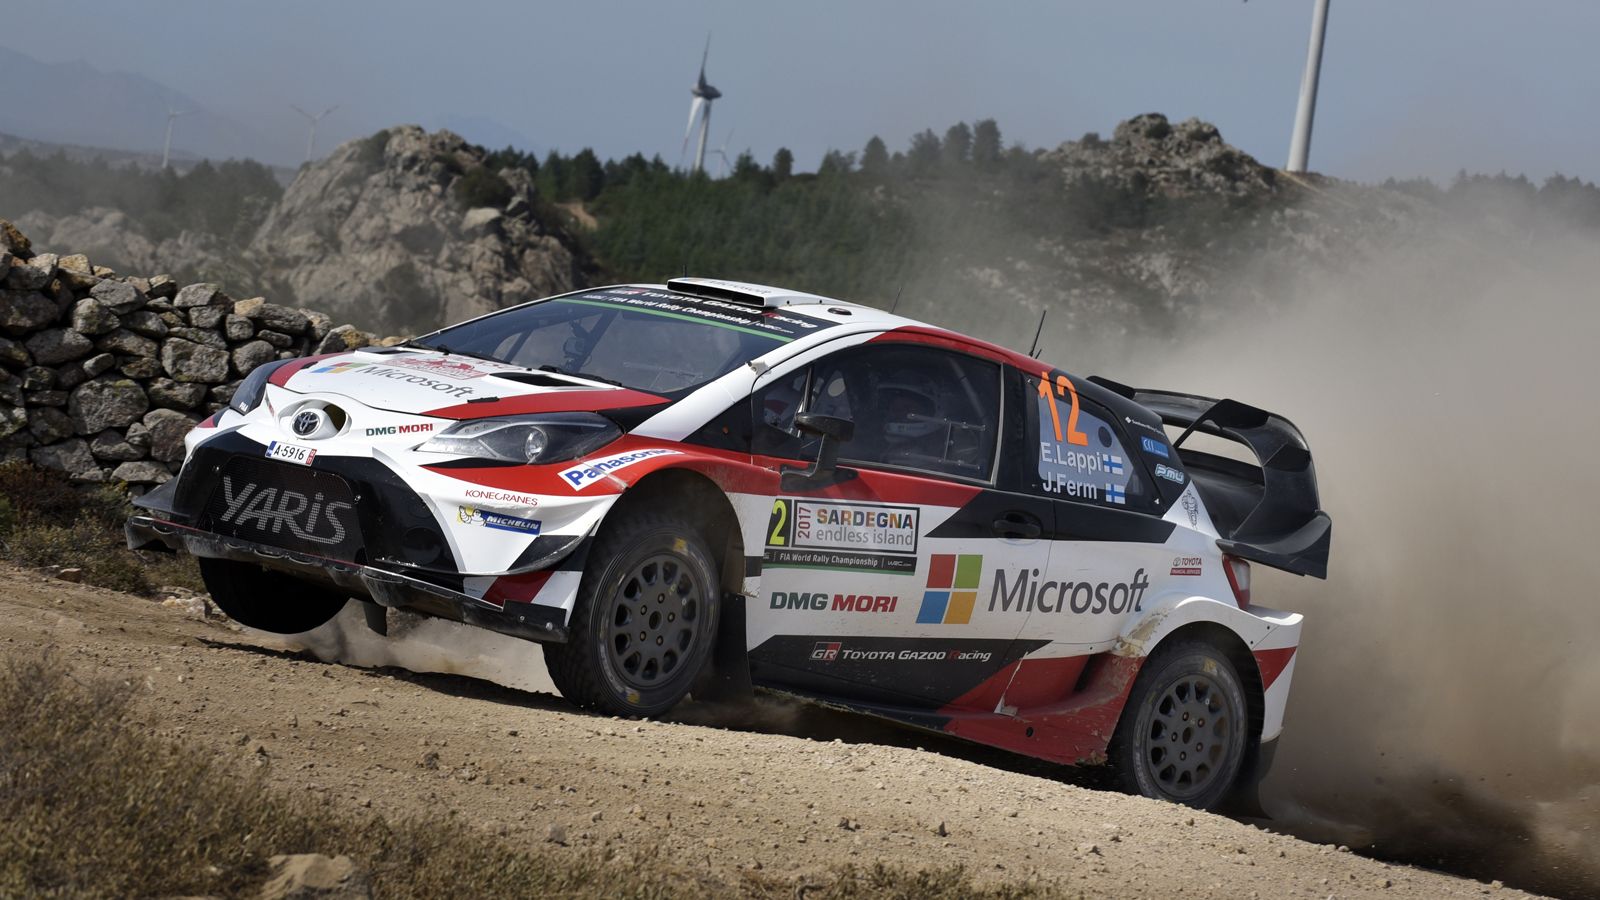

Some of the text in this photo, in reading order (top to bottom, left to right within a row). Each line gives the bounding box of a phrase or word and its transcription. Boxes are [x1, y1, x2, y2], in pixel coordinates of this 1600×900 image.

[641, 292, 702, 303] TOYOTA
[702, 300, 762, 314] GAZOO
[355, 365, 475, 399] Microsoft
[1038, 371, 1089, 446] 12
[366, 423, 434, 437] DMG MORI
[1040, 442, 1102, 475] E.Lappi
[1042, 471, 1098, 500] J.Ferm
[465, 489, 539, 507] KONECRANES
[486, 514, 540, 530] MICHELIN
[797, 506, 812, 539] 2017
[816, 508, 914, 530] SARDEGNA
[816, 527, 913, 546] endless island
[779, 552, 791, 561] FIA
[792, 553, 812, 562] World
[812, 555, 830, 565] Rally
[831, 555, 879, 568] Championship
[1181, 557, 1202, 566] TOYOTA
[769, 591, 898, 612] DMG MORI
[987, 568, 1149, 615] Microsoft
[811, 649, 992, 663] GR TOYOTA GAZOO Racing
